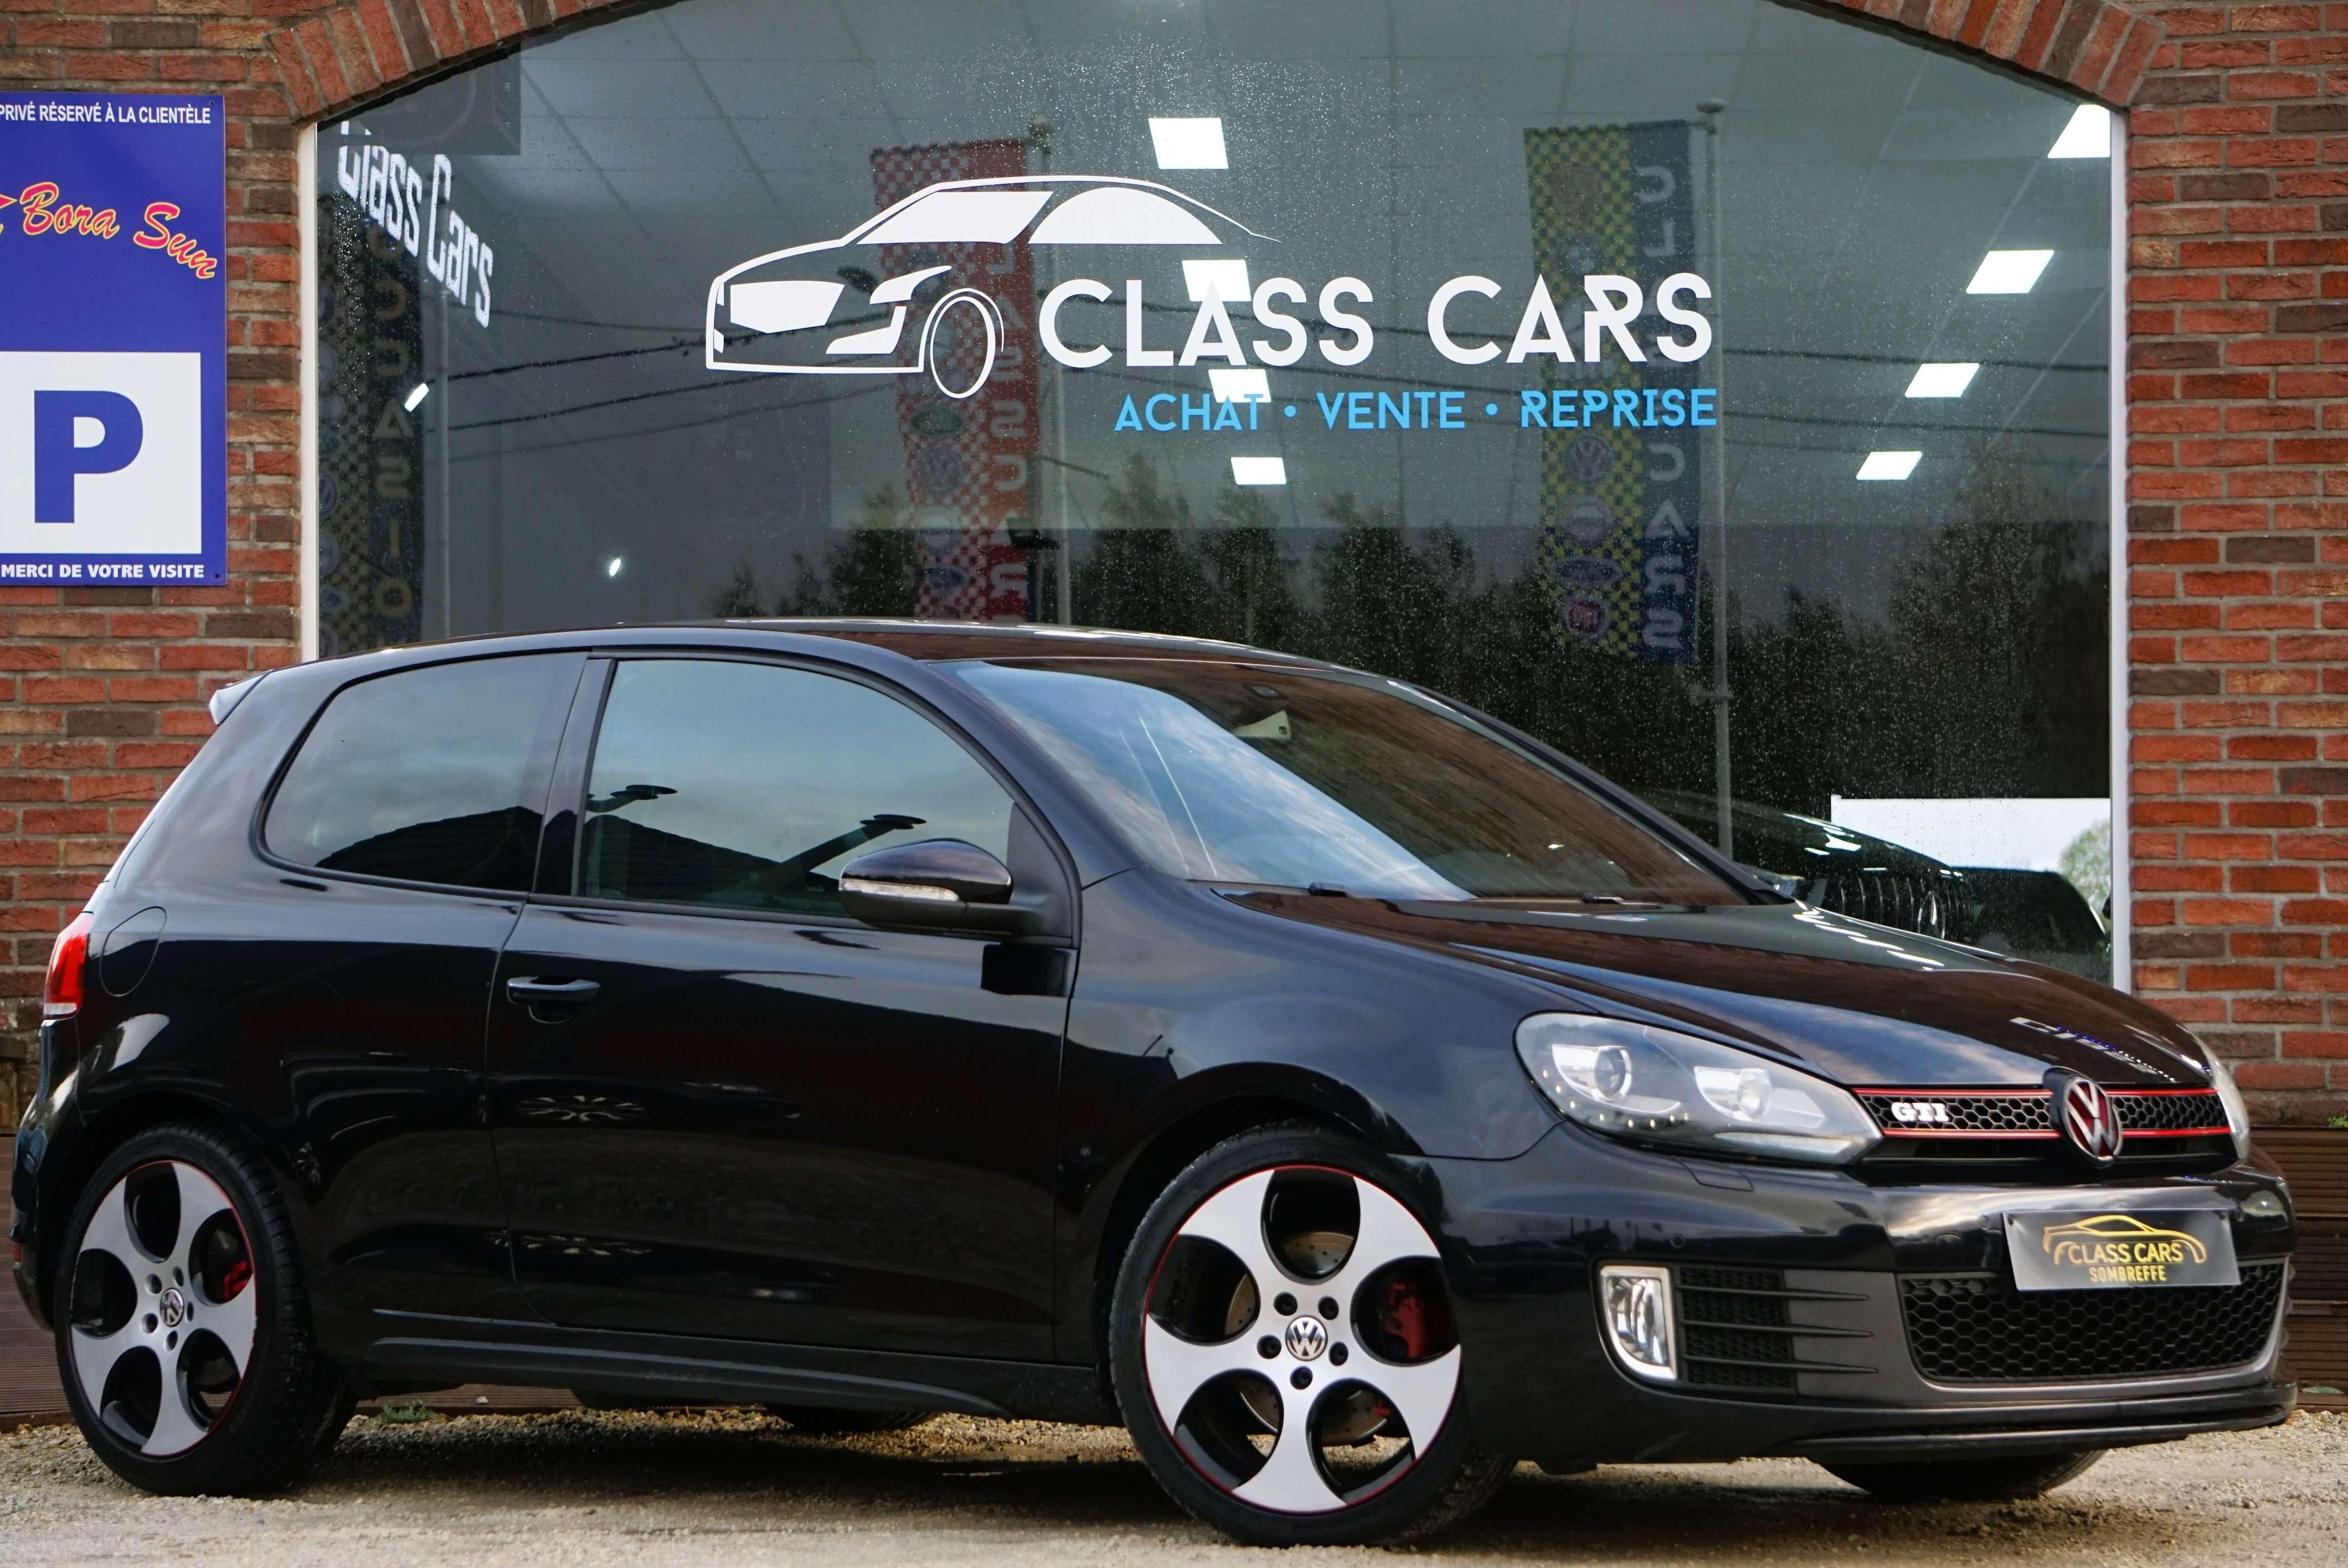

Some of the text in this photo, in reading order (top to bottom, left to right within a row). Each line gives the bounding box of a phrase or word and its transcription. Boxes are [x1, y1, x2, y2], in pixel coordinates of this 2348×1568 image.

[39, 101, 102, 122] RÉSERVÉ
[105, 102, 115, 122] À
[119, 106, 136, 123] LA
[139, 104, 211, 123] CLIENTÈLE
[19, 182, 218, 278] Bora Sun
[427, 154, 493, 328] Cars
[1039, 272, 1712, 368] CLASS CARS
[1114, 388, 1716, 431] ACHAT VENTE REPRISE
[34, 390, 143, 523] P
[1, 564, 204, 579] MERCI DE VOTRE VISITE
[1891, 1102, 1949, 1122] GTI
[2068, 1242, 2184, 1264] CLASS CARS
[2089, 1265, 2167, 1283] SOMBREFFE
